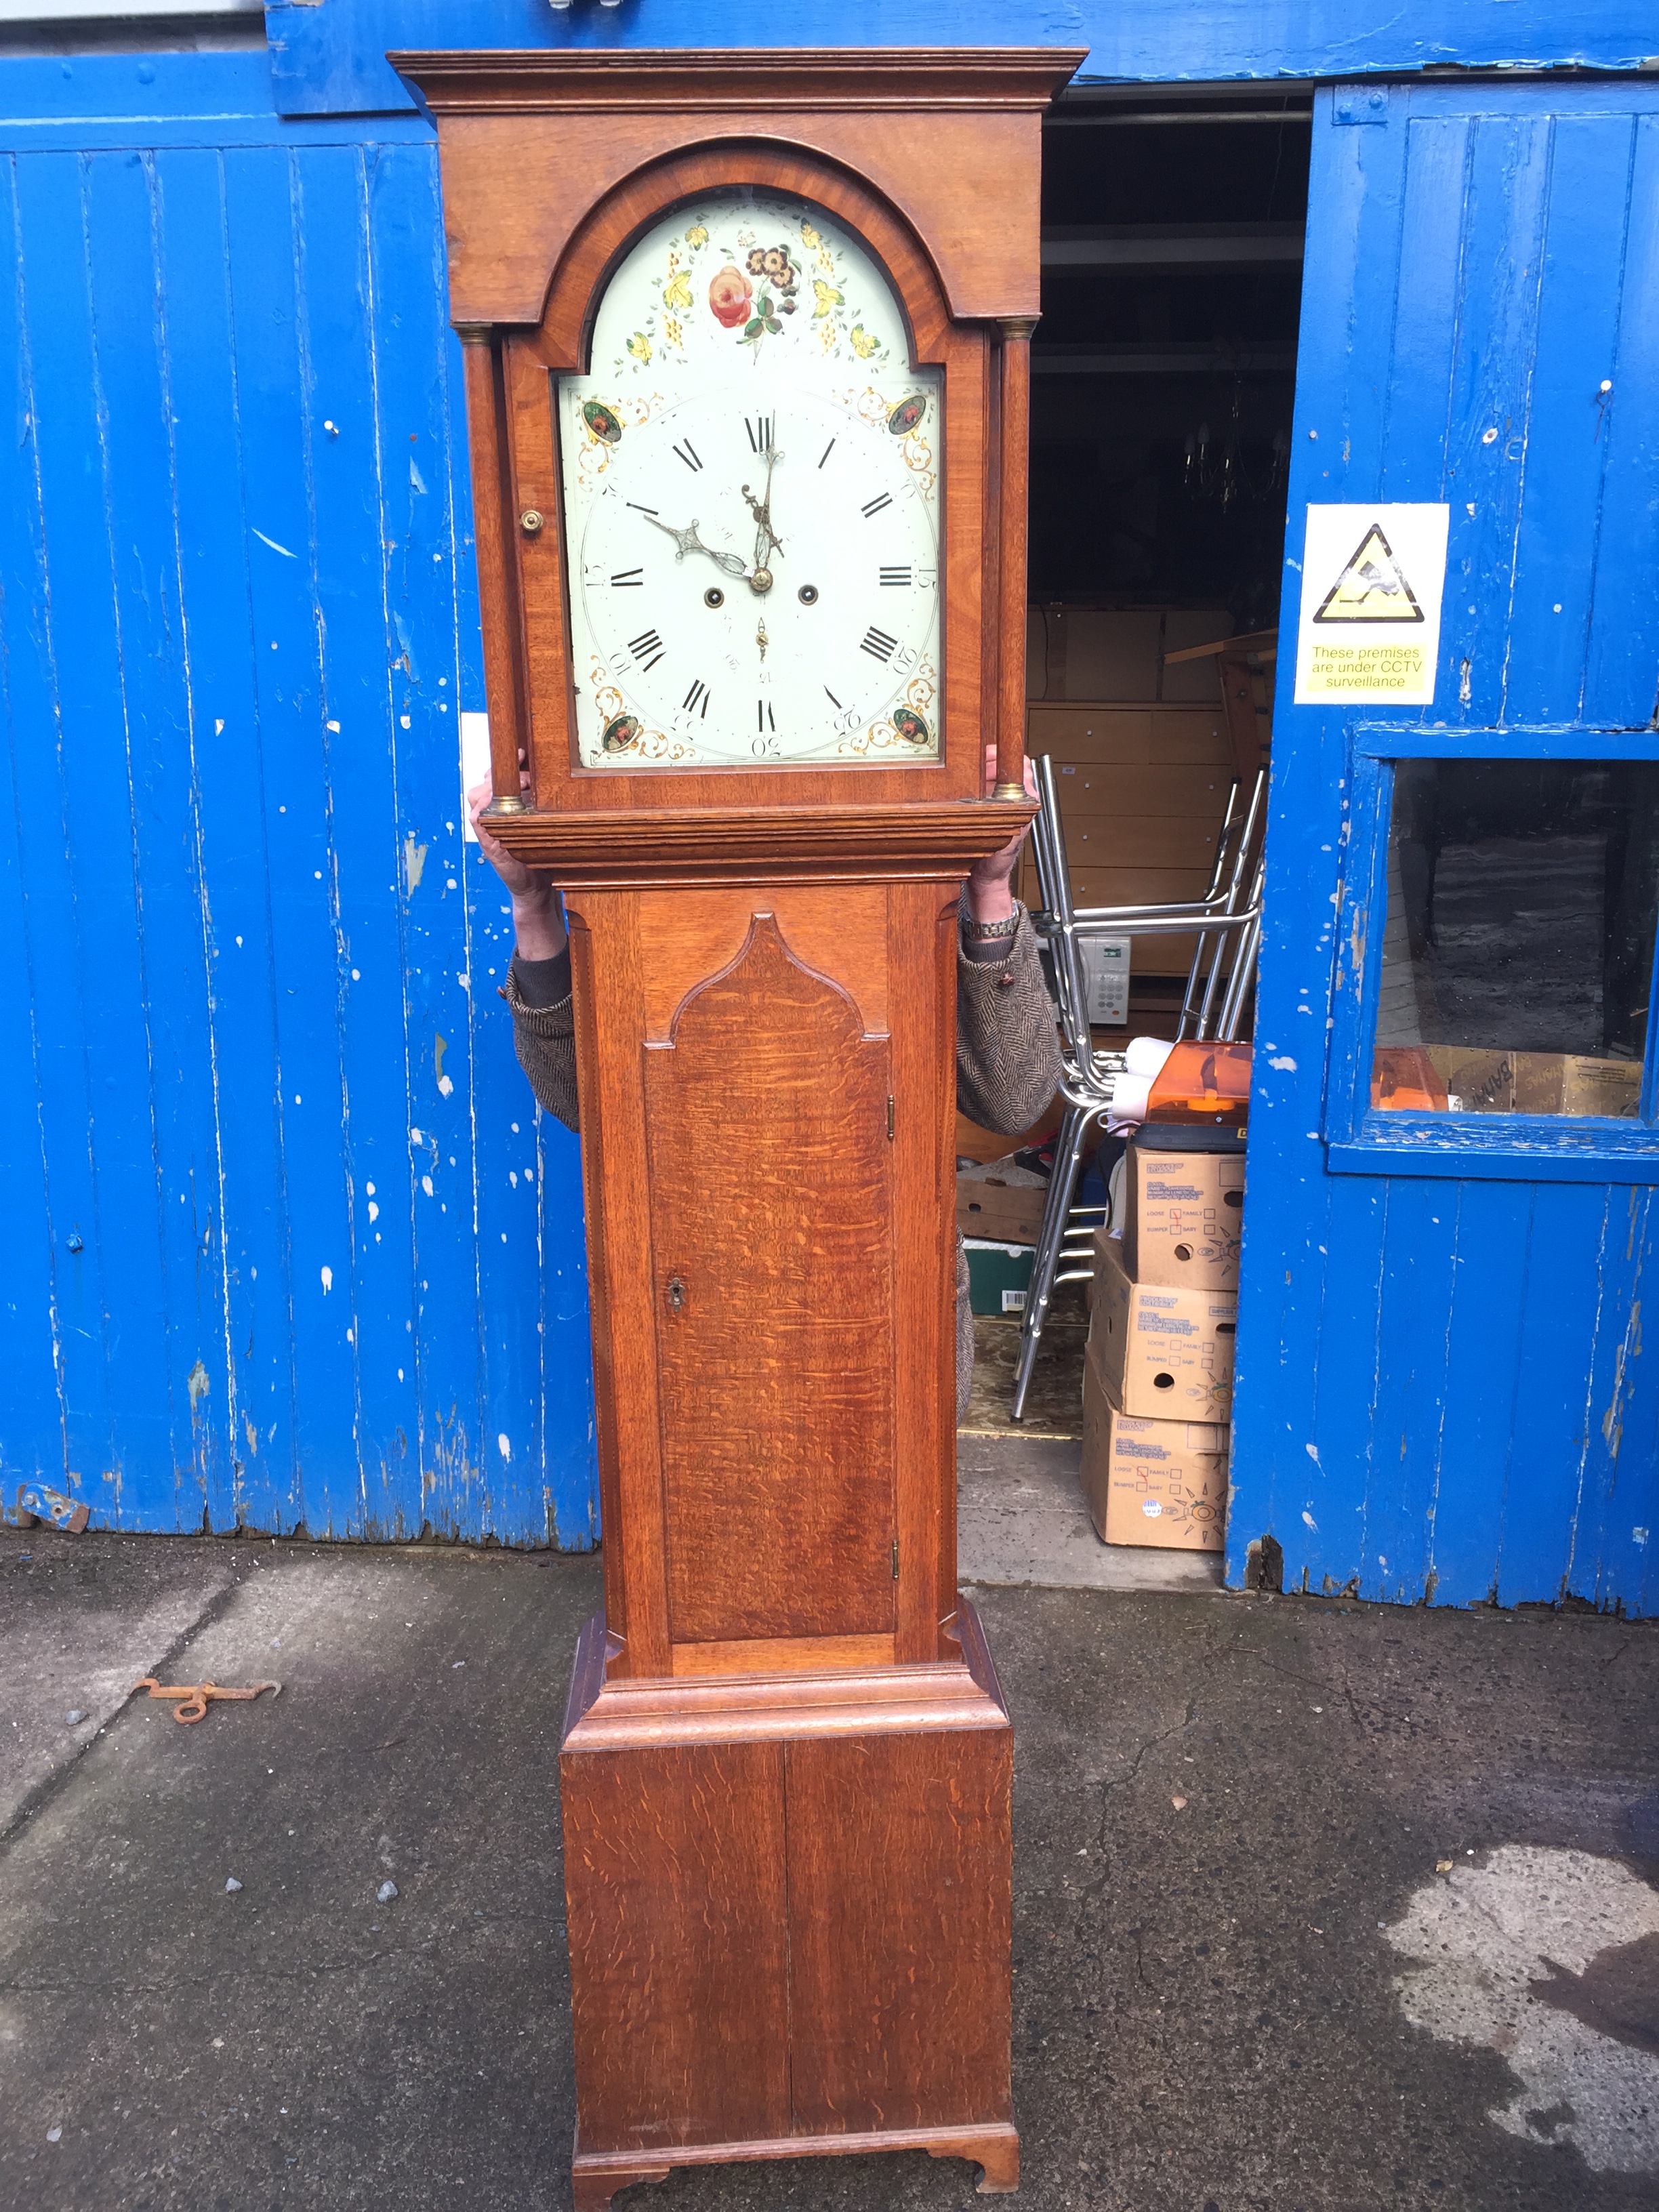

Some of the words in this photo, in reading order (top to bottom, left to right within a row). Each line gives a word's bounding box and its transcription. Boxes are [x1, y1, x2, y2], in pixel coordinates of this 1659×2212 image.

[861, 492, 893, 518] II
[879, 567, 912, 586] III
[859, 626, 899, 663] IIII
[1313, 647, 1353, 658] These
[1359, 646, 1420, 660] premises
[893, 646, 918, 675] 20
[1312, 663, 1334, 672] are
[1338, 661, 1376, 672] under
[1380, 661, 1422, 672] CCTV
[1326, 676, 1406, 688] surveillance
[752, 737, 782, 758] 30
